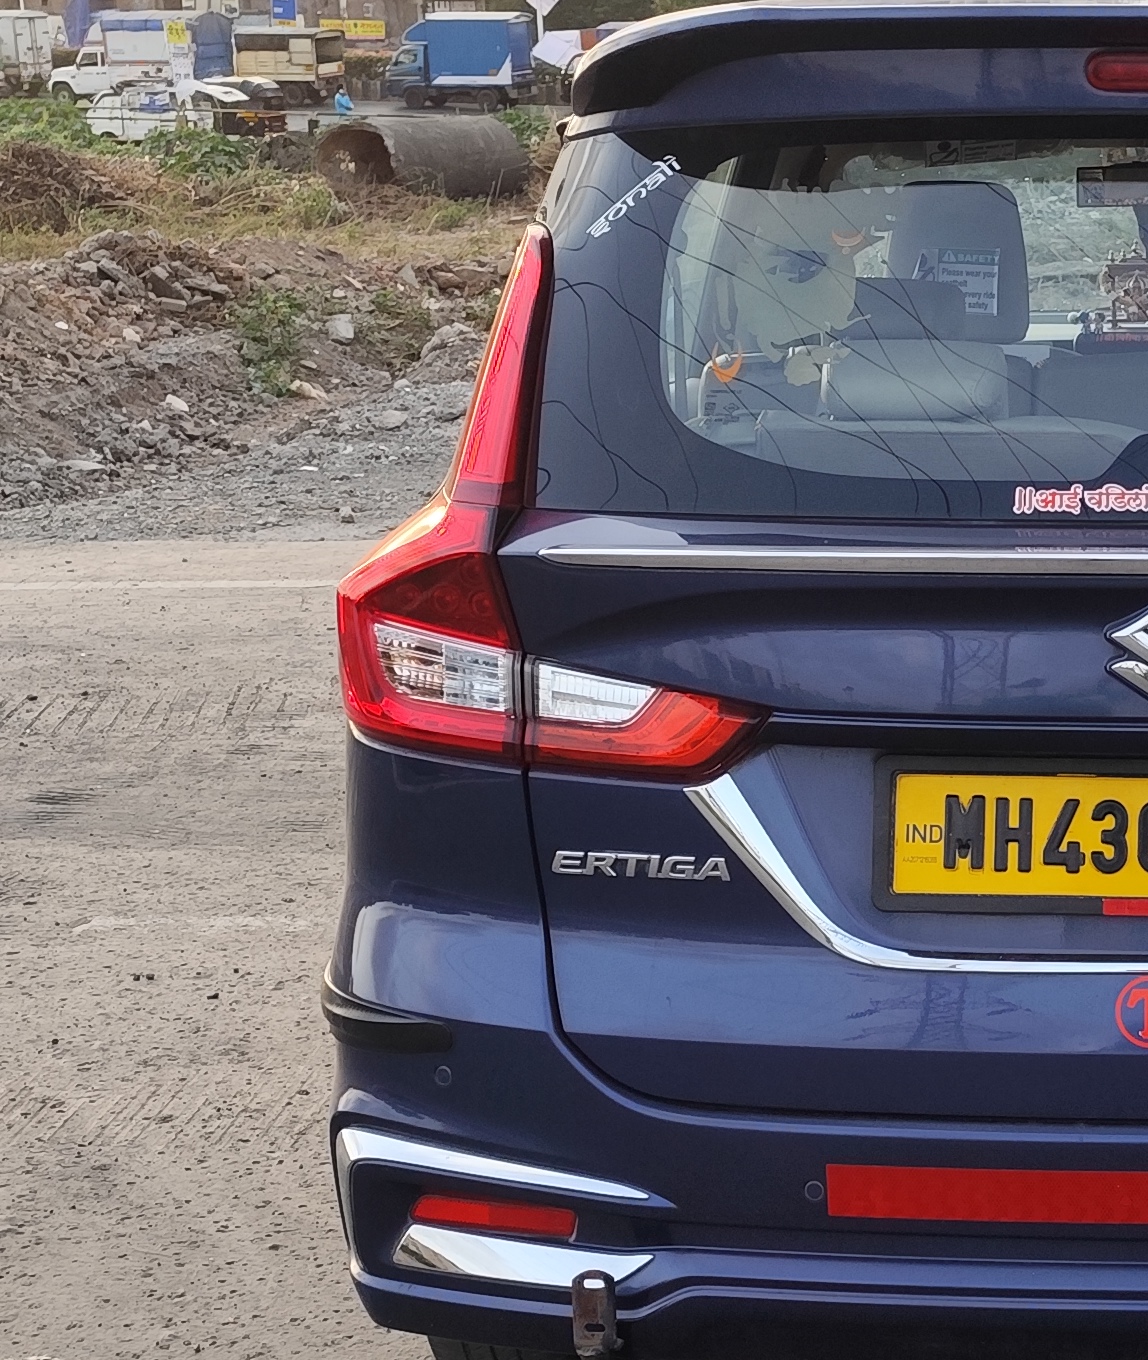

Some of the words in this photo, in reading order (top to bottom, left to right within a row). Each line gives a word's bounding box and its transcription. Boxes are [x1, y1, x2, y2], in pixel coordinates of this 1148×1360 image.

[957, 253, 999, 264] SAFETY
[941, 267, 963, 277] Please
[965, 270, 981, 278] wear
[983, 271, 997, 280] your
[982, 291, 996, 300] ride
[967, 301, 989, 311] safety
[905, 822, 943, 844] IND
[551, 850, 731, 882] ERTIGA
